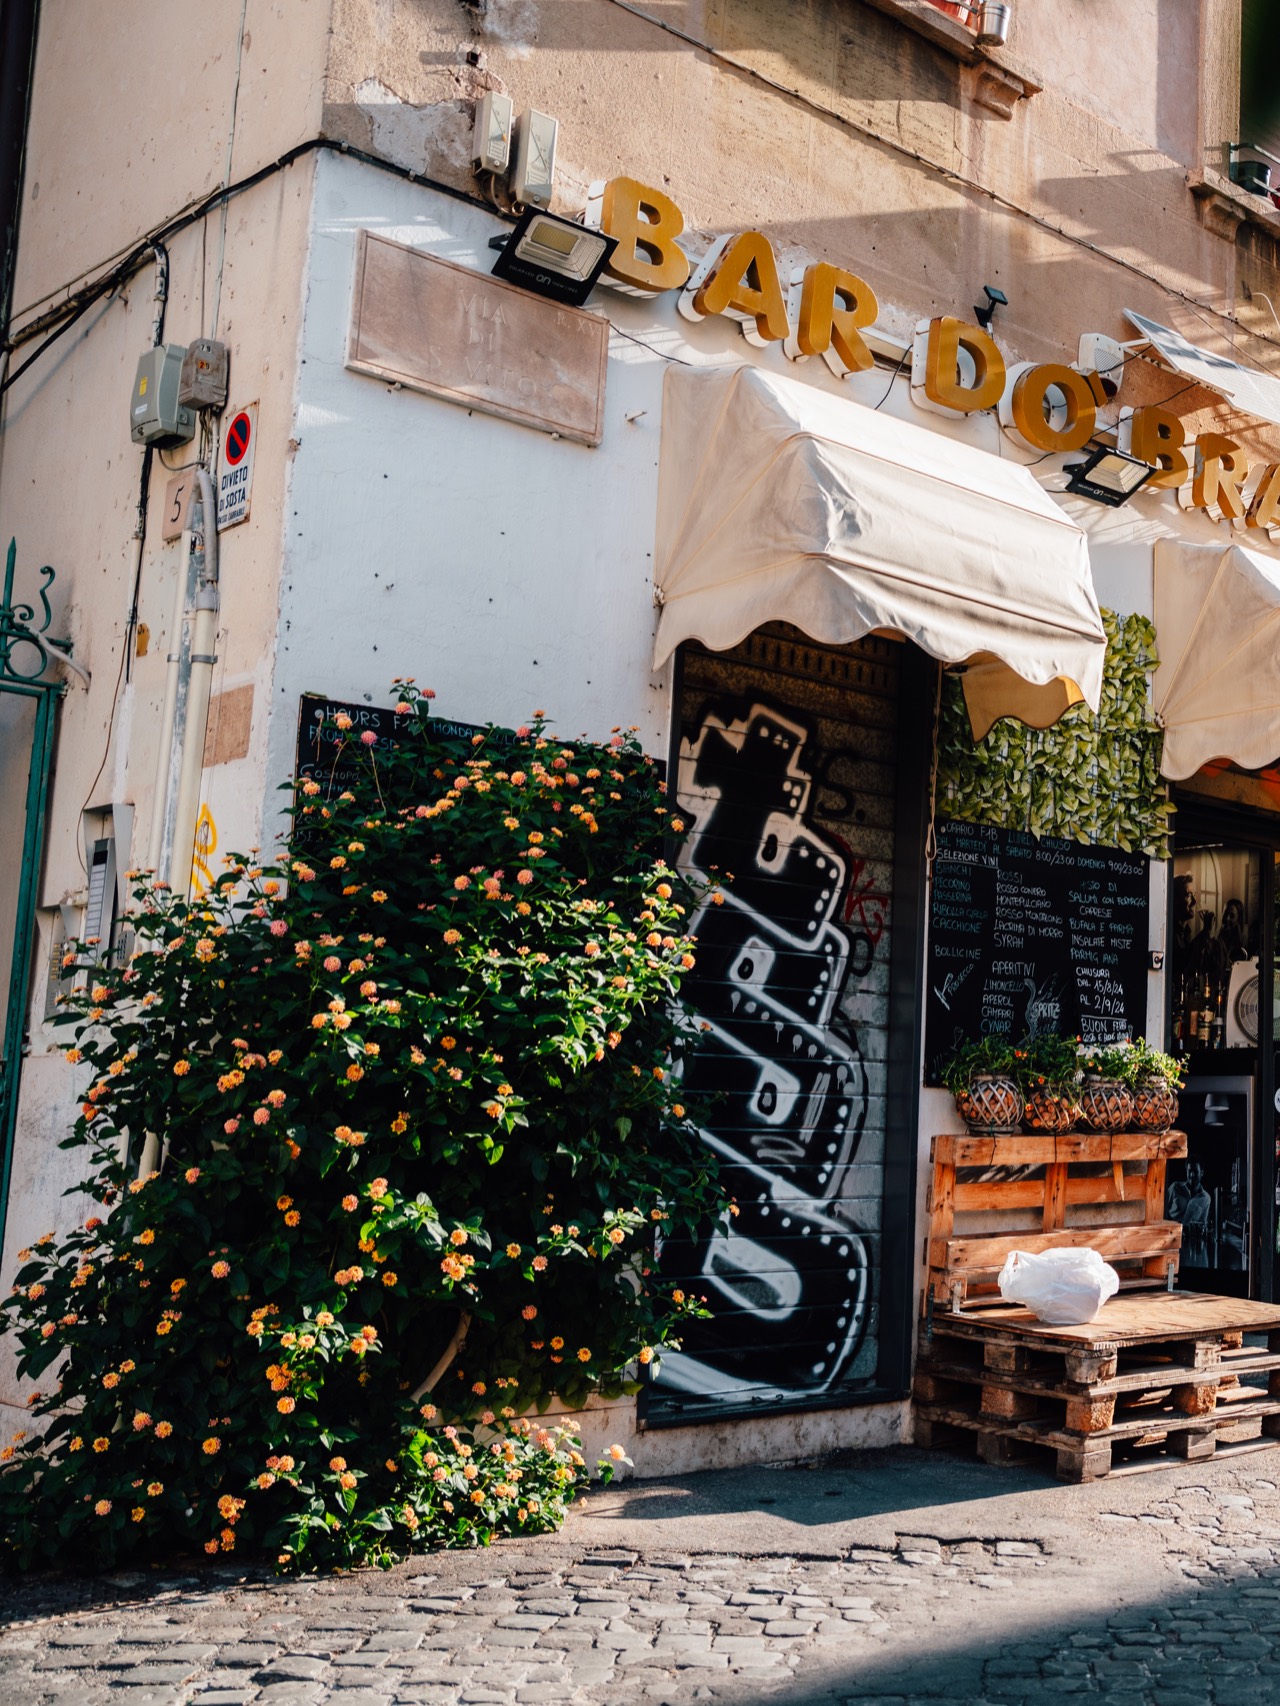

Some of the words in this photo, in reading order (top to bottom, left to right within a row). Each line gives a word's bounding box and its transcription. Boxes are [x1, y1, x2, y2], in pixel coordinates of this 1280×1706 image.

[602, 176, 880, 373] BAR
[459, 289, 507, 326] VIA
[469, 327, 493, 352] DI
[465, 356, 537, 397] VITO
[222, 466, 248, 491] DIVIETO
[171, 485, 185, 522] 5
[225, 487, 246, 509] SOSTA
[433, 722, 473, 739] MONDA
[993, 844, 1002, 855] AL
[1005, 845, 1033, 858] SABATO
[1040, 839, 1071, 852] CHIUSO
[936, 848, 979, 863] SELEZIONE
[981, 854, 999, 867] VINI
[935, 861, 972, 877] BIANCHI
[997, 868, 1023, 884] ROSSI
[996, 882, 1019, 894] ROSSO
[1020, 885, 1047, 897] CONERO
[1108, 882, 1118, 892] DI
[1102, 896, 1114, 905] CON
[932, 902, 964, 916] RIBOLLA
[995, 907, 1023, 919] ROSSO
[1079, 905, 1112, 918] CAPRESE
[932, 916, 982, 933] CACCHIONE
[994, 919, 1025, 933] LACRIMA
[1028, 925, 1036, 936] DI
[1039, 927, 1064, 938] MORRO
[1069, 917, 1096, 931] BUFALA
[1100, 922, 1105, 932] E
[1109, 922, 1134, 935] PARMA
[993, 932, 1024, 948] SYRAH
[1071, 933, 1105, 947] INSALATE
[1110, 938, 1132, 950] MISTE
[934, 944, 982, 960] BOLLICINE
[947, 963, 974, 996] PROSECCO
[1076, 966, 1110, 978] CHIUSURA
[984, 979, 1024, 992] LIMONCELLO
[1077, 978, 1091, 987] DAL
[1093, 979, 1124, 996] 15/8/24
[982, 994, 1014, 1007] APEROL
[1080, 994, 1091, 1006] AL
[1094, 995, 1124, 1016] 2/9/24
[981, 1006, 1014, 1020] CAMPARI
[980, 1018, 1011, 1033] CYNAR
[1081, 1018, 1108, 1033] BUON
